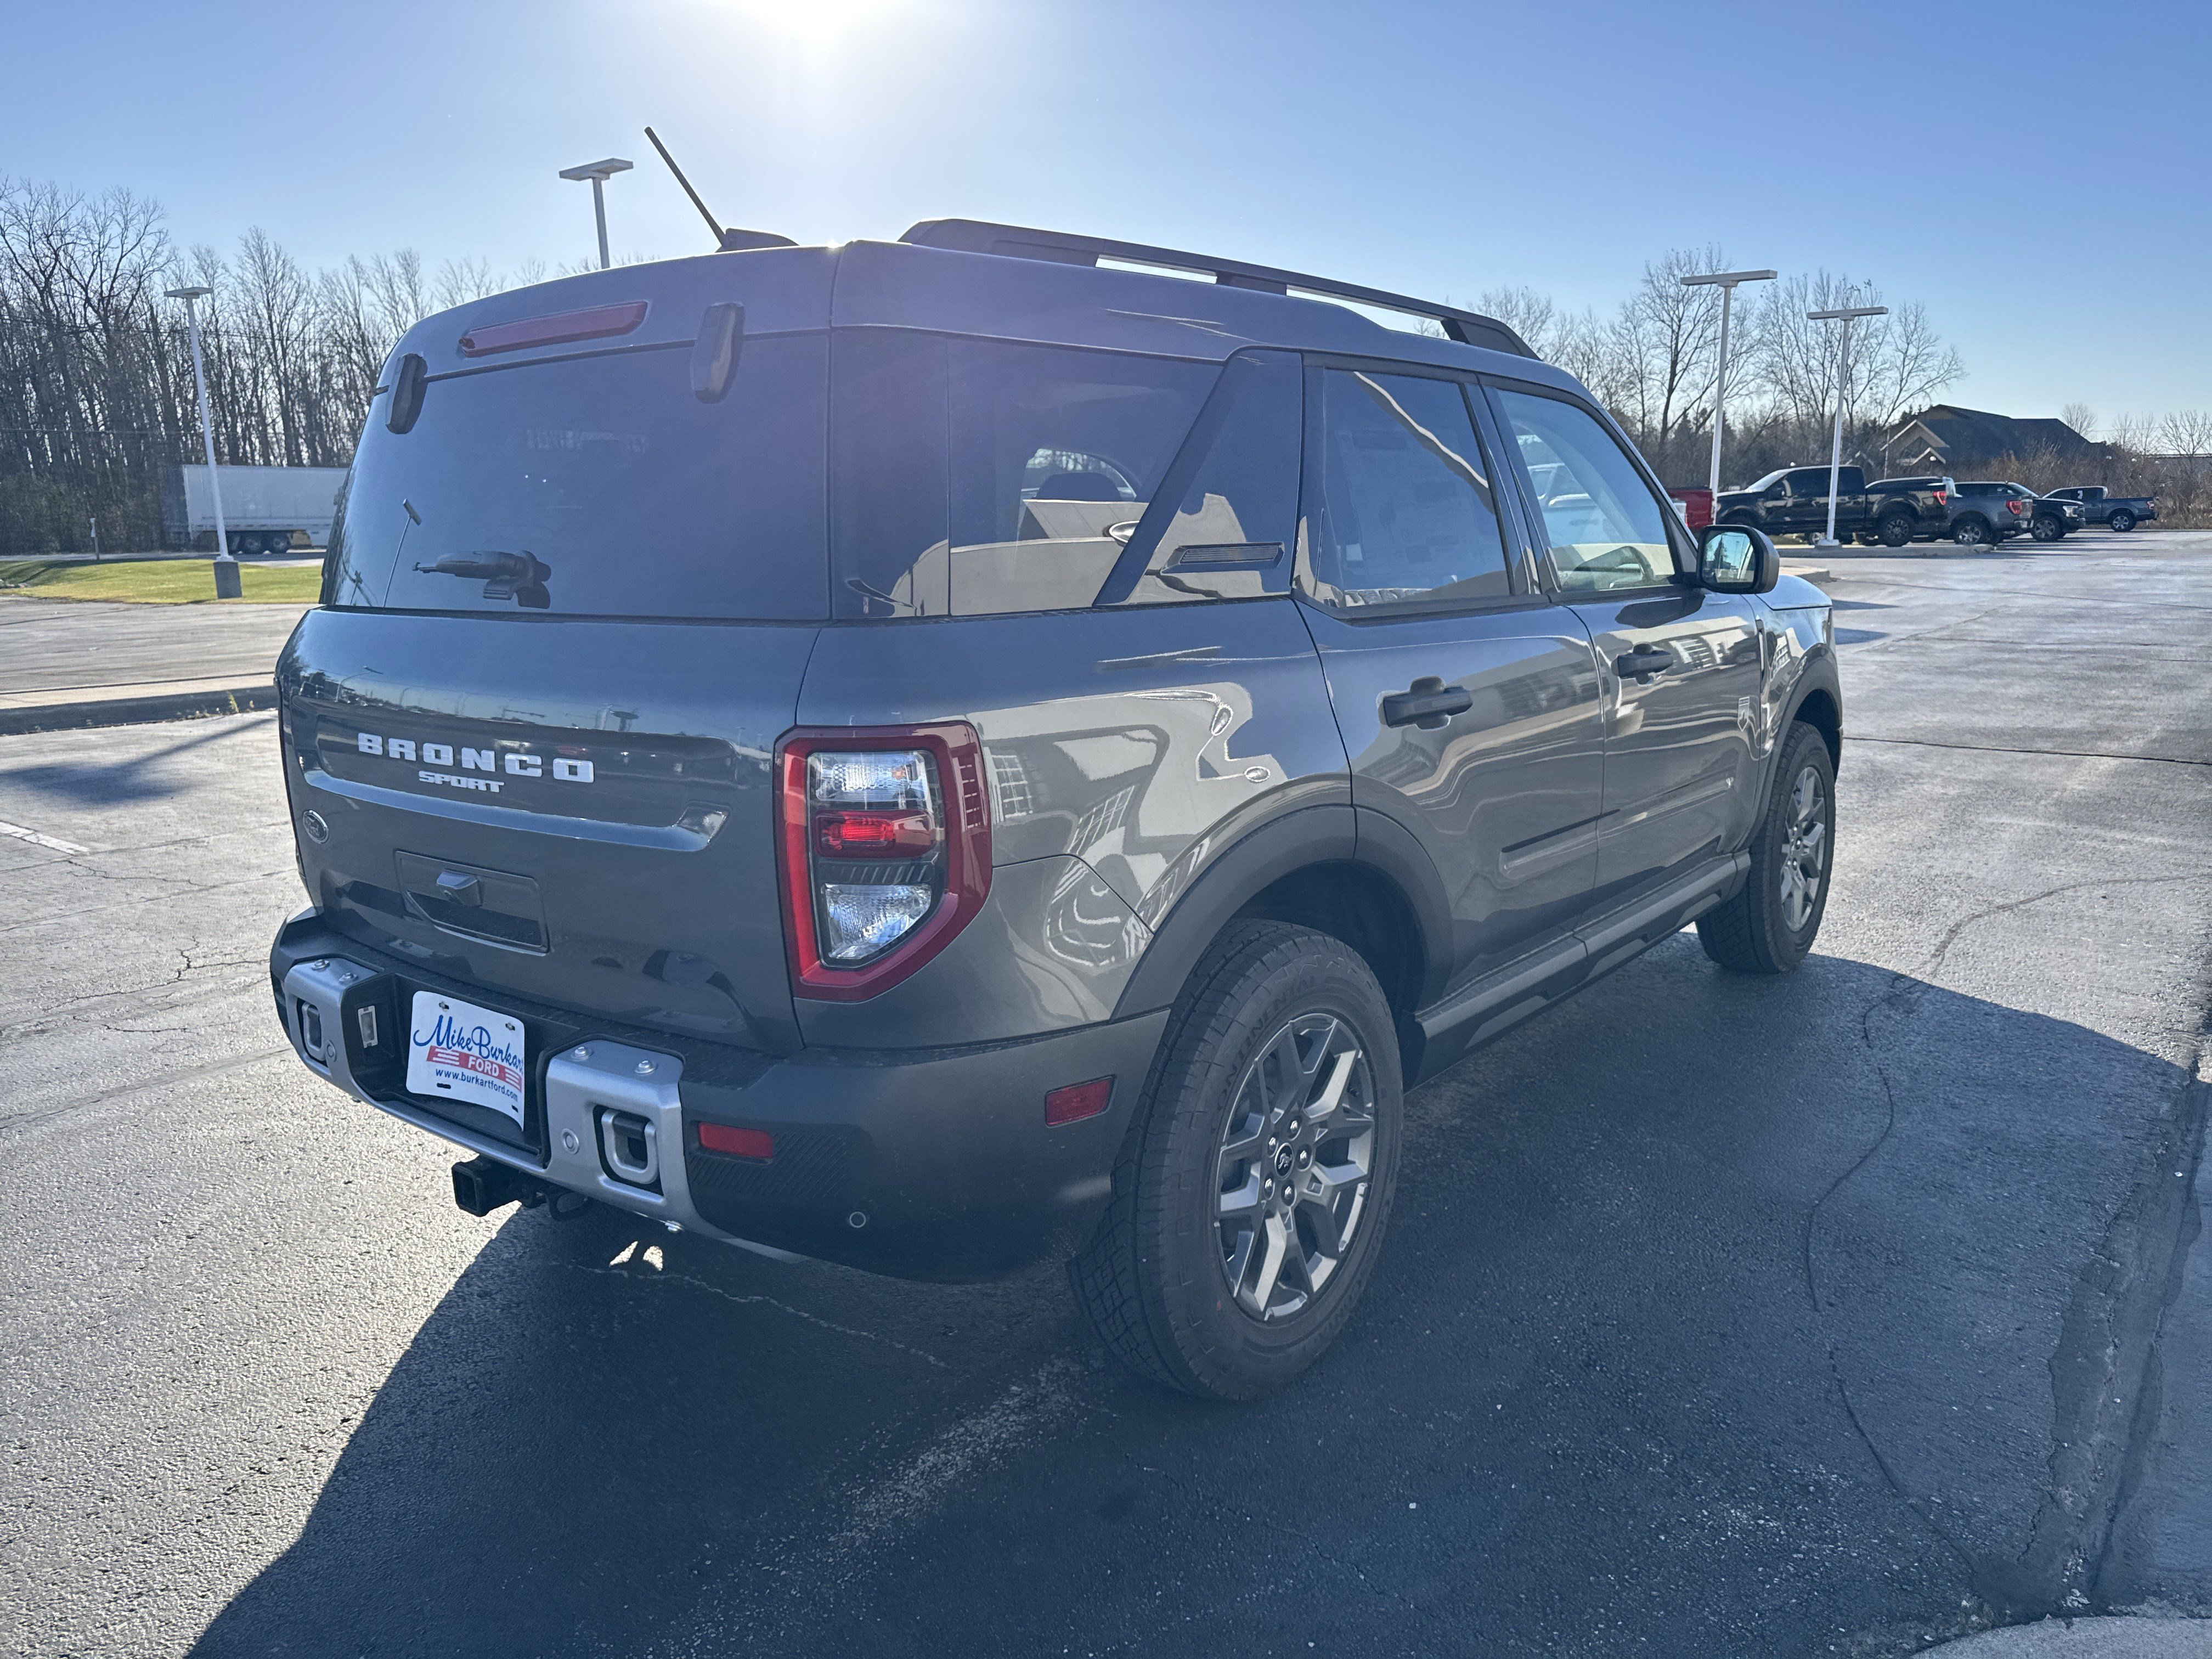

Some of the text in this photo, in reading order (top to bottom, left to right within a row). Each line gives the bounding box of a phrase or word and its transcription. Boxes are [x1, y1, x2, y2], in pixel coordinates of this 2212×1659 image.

[358, 732, 594, 783] BRONCO
[419, 771, 505, 793] SPORT
[413, 1014, 473, 1052] Mike
[468, 1056, 499, 1077] FORD
[436, 1069, 518, 1102] www.burkartford.com
